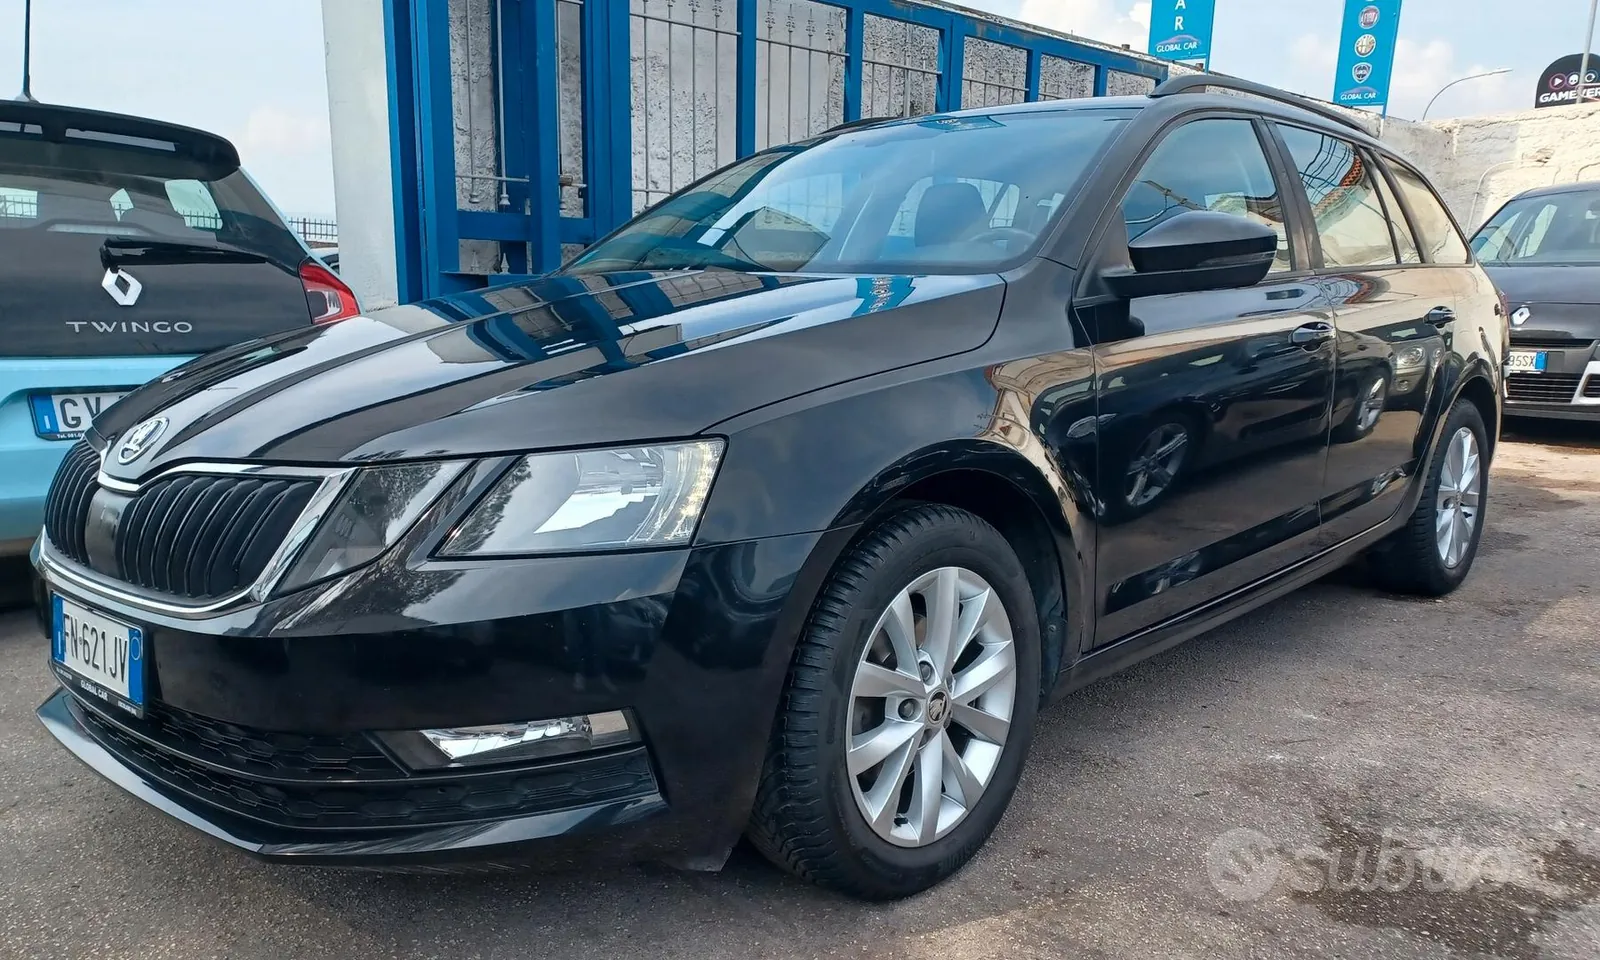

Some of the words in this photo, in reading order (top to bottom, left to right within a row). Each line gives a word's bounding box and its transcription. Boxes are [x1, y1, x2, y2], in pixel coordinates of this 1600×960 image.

[1156, 43, 1182, 53] GLOBAL
[1183, 41, 1198, 50] CAR
[1340, 92, 1363, 101] GLOBAL
[1363, 91, 1377, 99] CAR
[65, 320, 193, 334] TWINGO
[80, 680, 98, 696] GLOBAL
[98, 689, 109, 701] CAR
